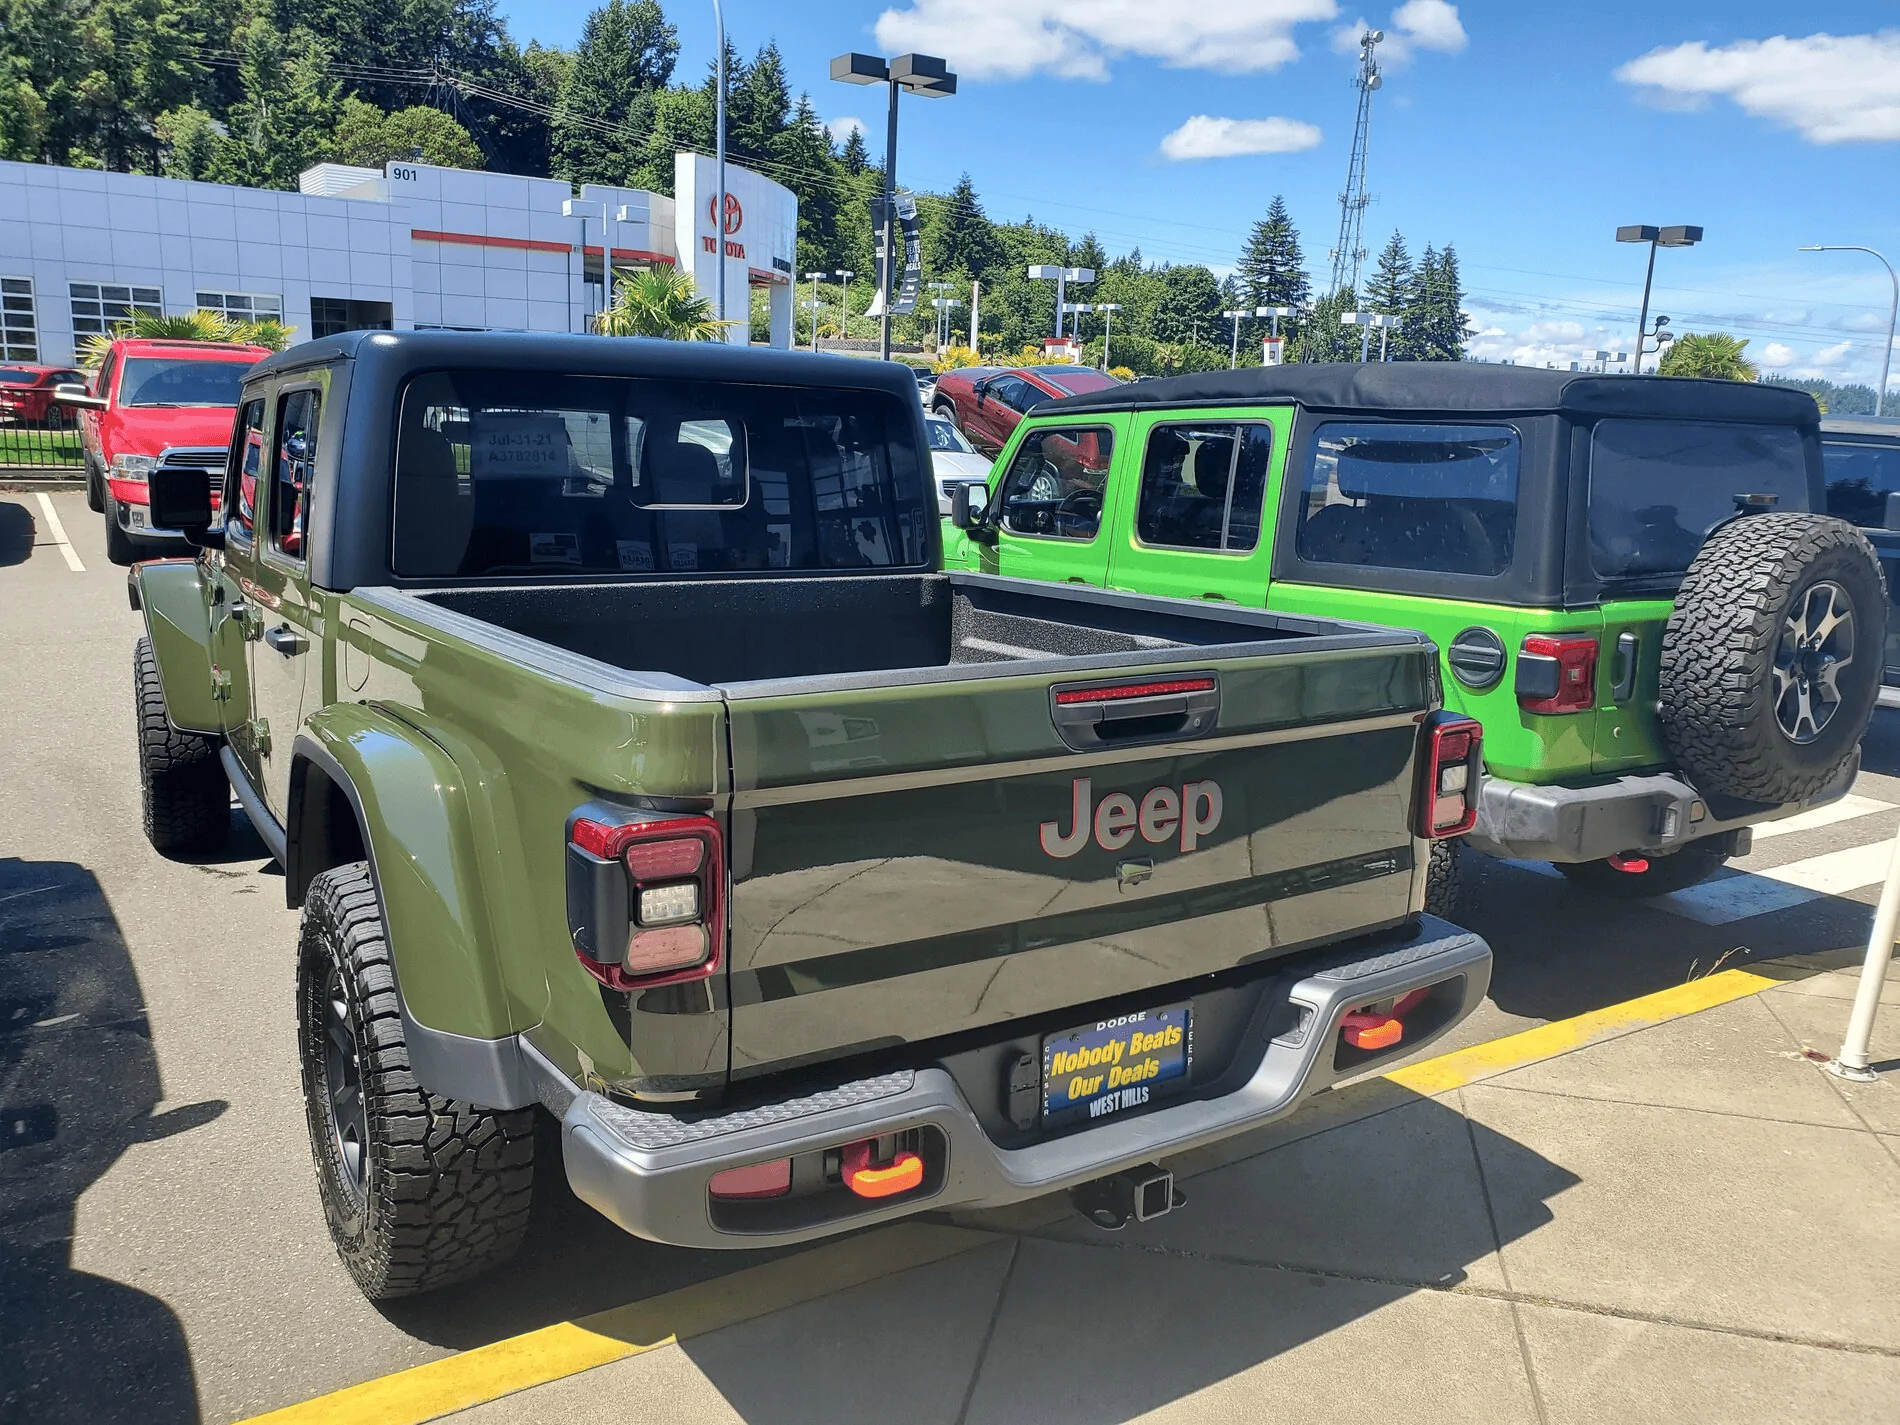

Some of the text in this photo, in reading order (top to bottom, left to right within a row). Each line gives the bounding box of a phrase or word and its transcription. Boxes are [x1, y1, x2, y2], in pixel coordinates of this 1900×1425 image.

[393, 168, 417, 181] 901
[703, 236, 745, 259] TOOTA
[905, 262, 921, 272] DEALS
[488, 433, 552, 446] Jul-31-21
[1039, 777, 1223, 859] Jeep
[1096, 1011, 1147, 1032] DODGE
[1051, 1024, 1183, 1077] Nobody Beats
[1067, 1057, 1160, 1101] Our Deals
[1089, 1086, 1149, 1118] WEST HILLS
